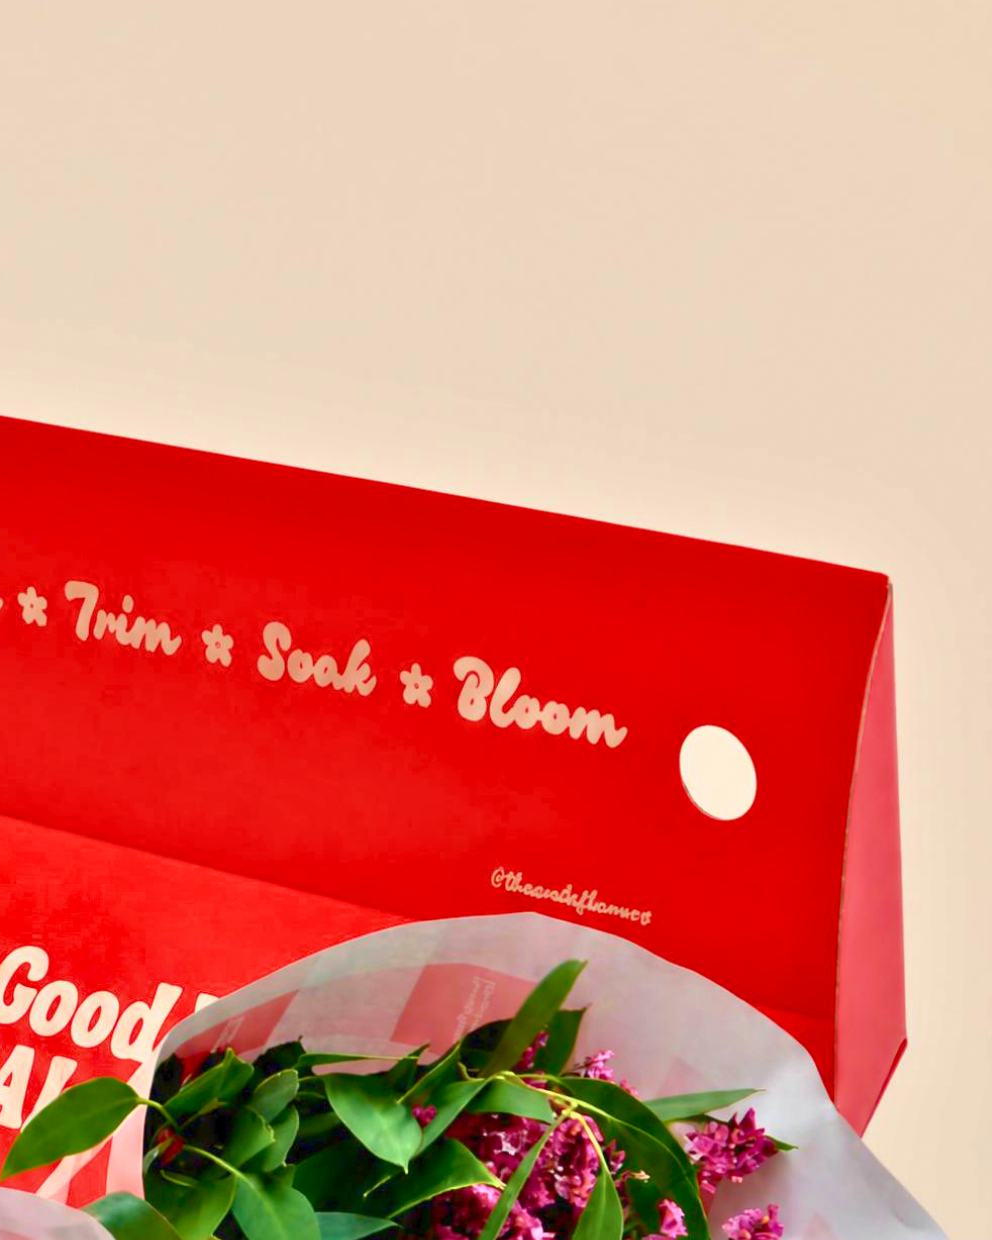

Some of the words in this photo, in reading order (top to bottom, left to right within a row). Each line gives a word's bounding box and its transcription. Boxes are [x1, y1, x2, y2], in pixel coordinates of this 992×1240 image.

[64, 580, 182, 656] Trim
[257, 621, 378, 697] Soak
[453, 656, 628, 749] Bloom
